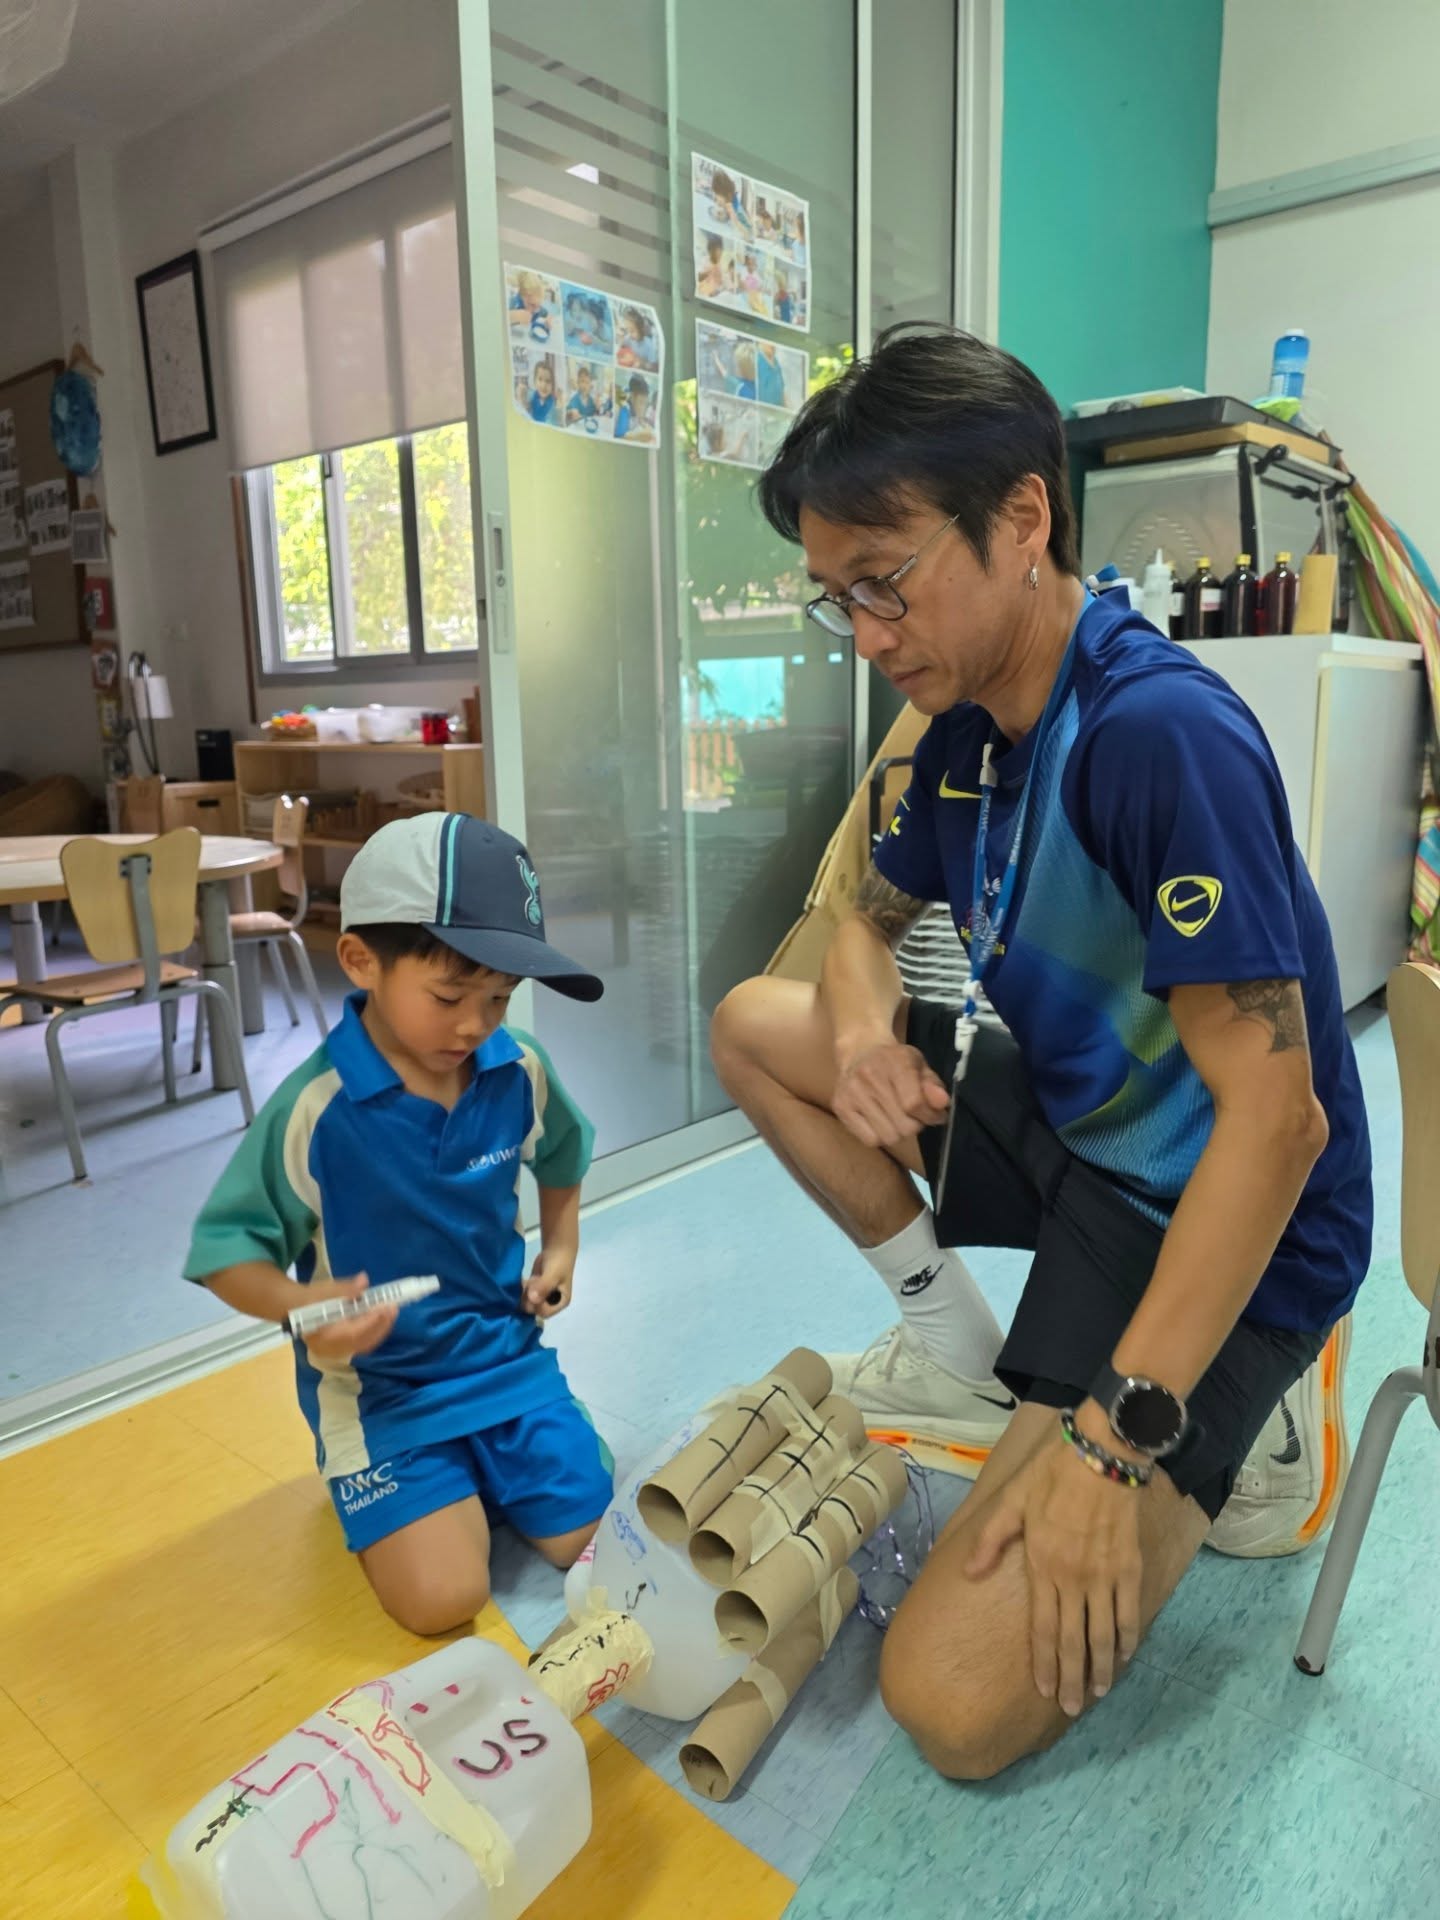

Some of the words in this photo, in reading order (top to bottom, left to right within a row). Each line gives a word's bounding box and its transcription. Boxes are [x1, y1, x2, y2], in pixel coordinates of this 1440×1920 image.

[339, 1462, 393, 1501] UWC
[344, 1481, 399, 1516] THAILAND
[452, 1718, 549, 1780] US
